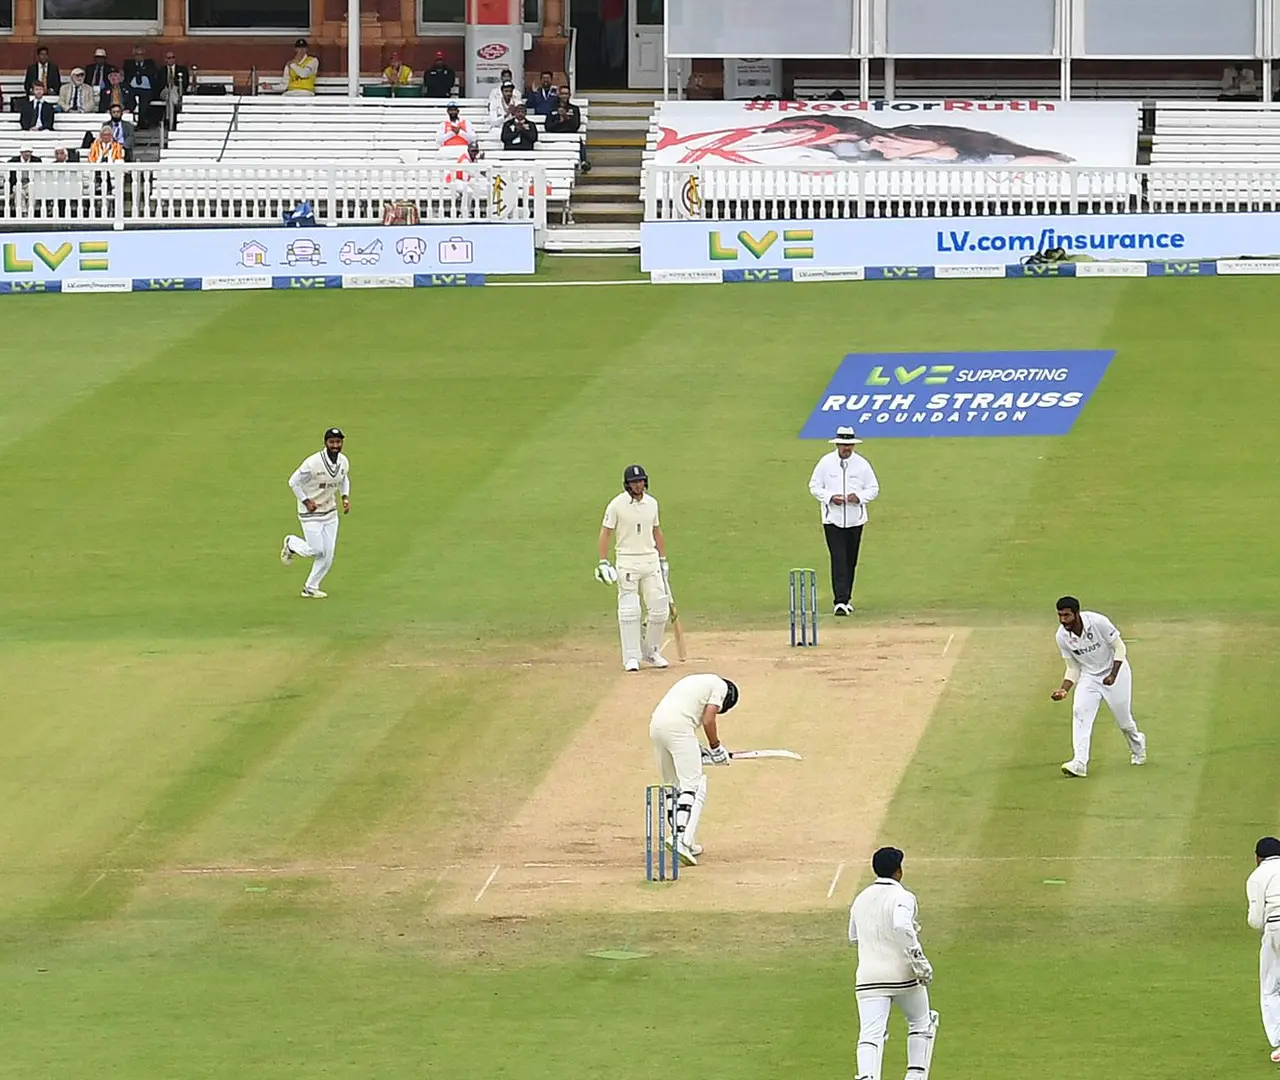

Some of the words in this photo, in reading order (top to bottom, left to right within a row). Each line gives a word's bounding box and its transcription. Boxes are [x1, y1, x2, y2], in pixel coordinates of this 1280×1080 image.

[743, 100, 1055, 112] #RedforRuth
[937, 229, 1185, 252] LV.com/insurance
[956, 368, 1069, 382] SUPPORTING
[821, 393, 916, 412] RUTH
[925, 391, 1084, 409] STRAUSS
[859, 410, 1027, 424] FOUNDATION
